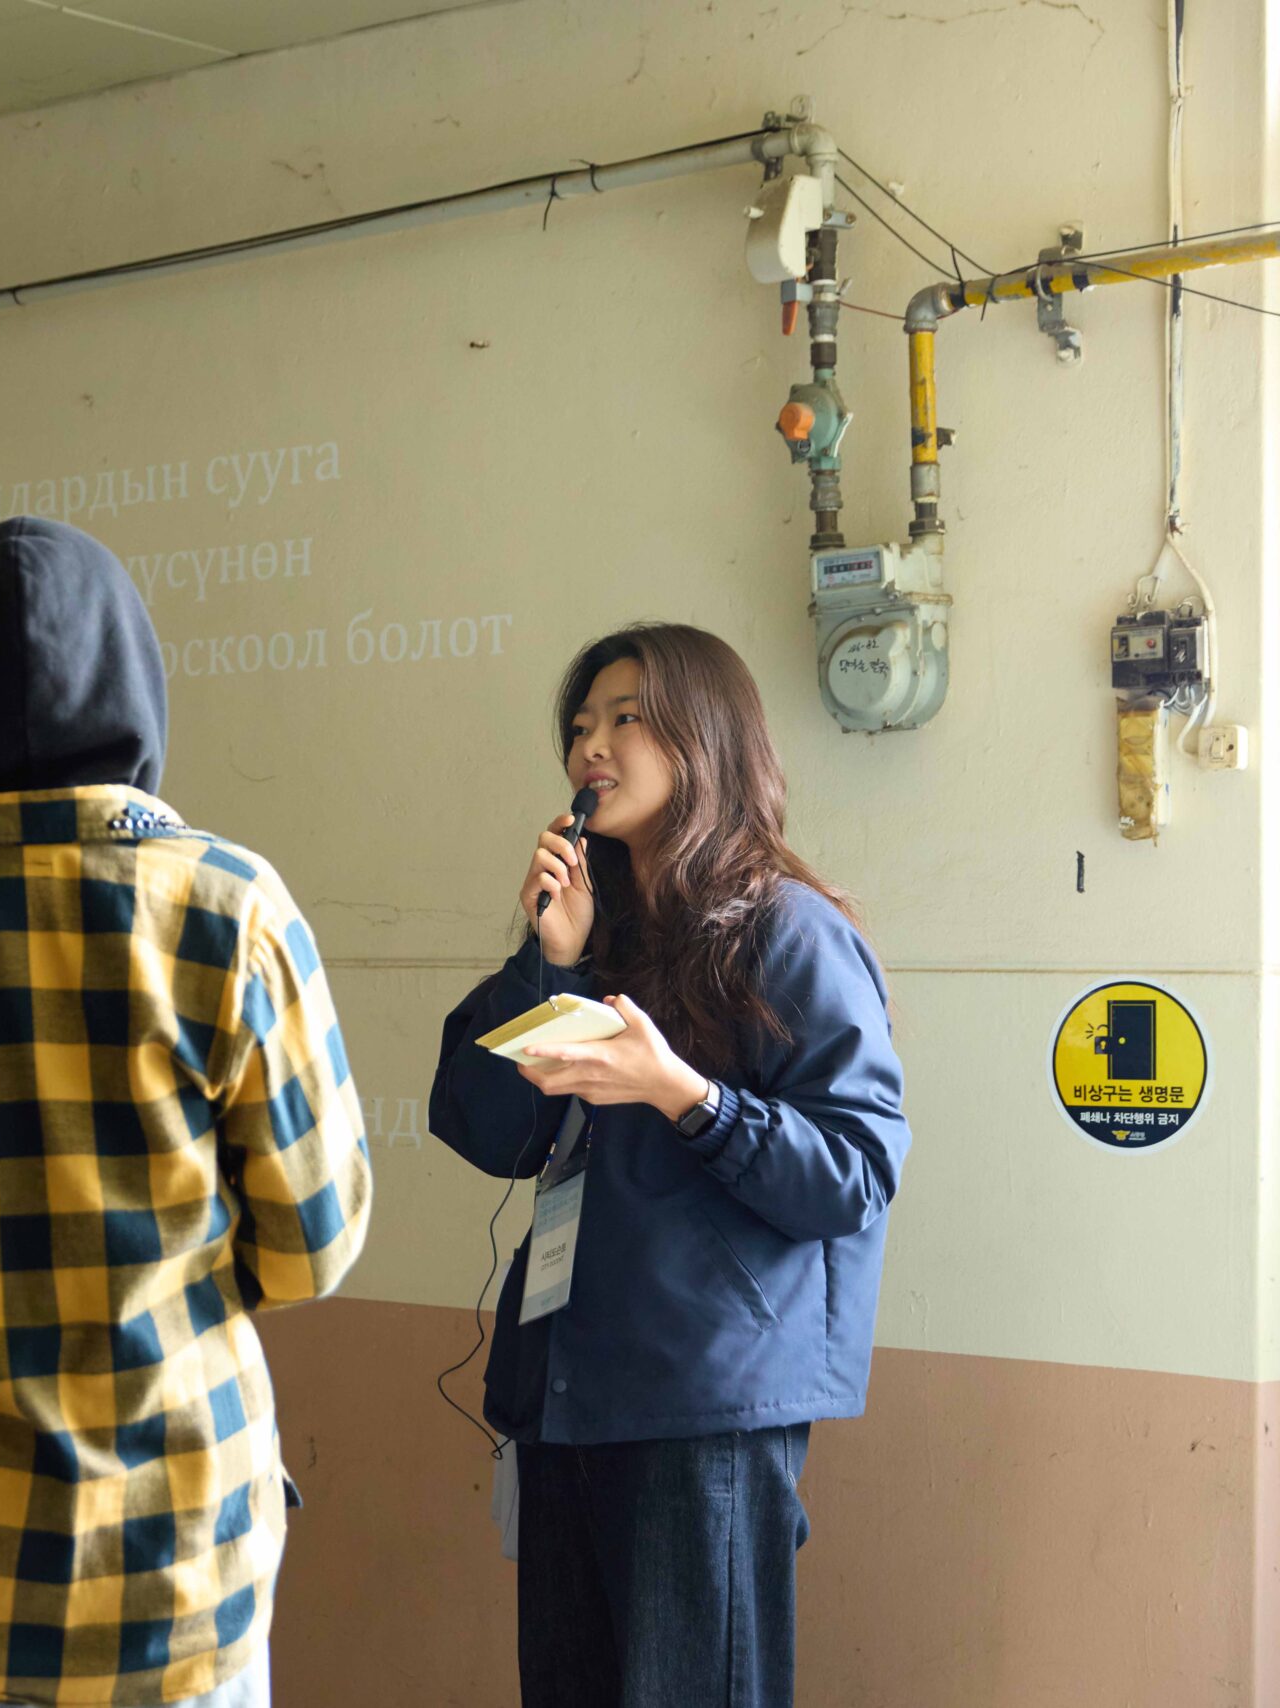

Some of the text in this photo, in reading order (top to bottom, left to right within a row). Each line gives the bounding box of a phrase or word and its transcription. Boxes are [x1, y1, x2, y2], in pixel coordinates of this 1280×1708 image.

[206, 441, 342, 509] сууга
[347, 608, 513, 665] болот
[1074, 1084, 1184, 1103] 비상구는 생명문
[1079, 1111, 1179, 1126] 폐쇄나 차단행위 금지
